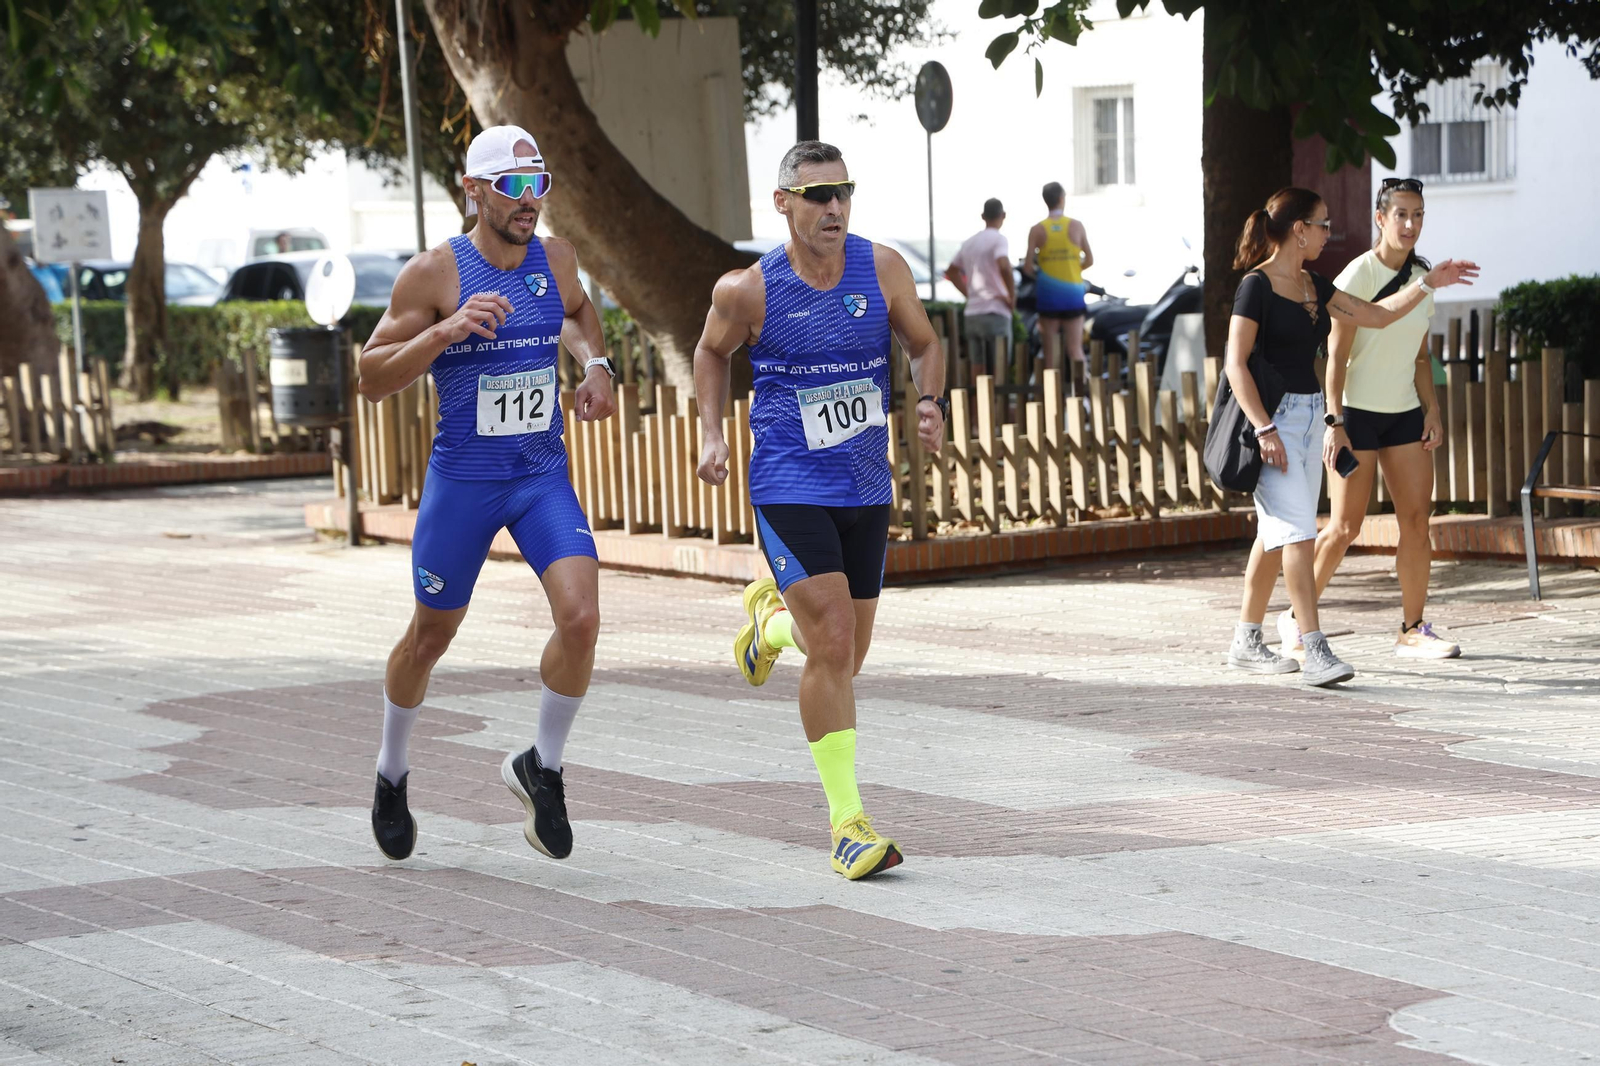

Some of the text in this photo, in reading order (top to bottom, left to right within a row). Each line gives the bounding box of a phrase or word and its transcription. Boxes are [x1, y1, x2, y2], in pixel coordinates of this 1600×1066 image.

[787, 310, 810, 319] mobel
[445, 344, 472, 355] CLUB
[476, 337, 539, 352] ATLETISMO
[789, 362, 858, 375] ATLETISMO
[515, 376, 531, 391] ELA
[532, 373, 551, 386] TARIFA
[833, 384, 851, 401] ELA
[851, 382, 874, 395] TARIFA
[494, 388, 544, 423] 112
[817, 396, 867, 434] 100
